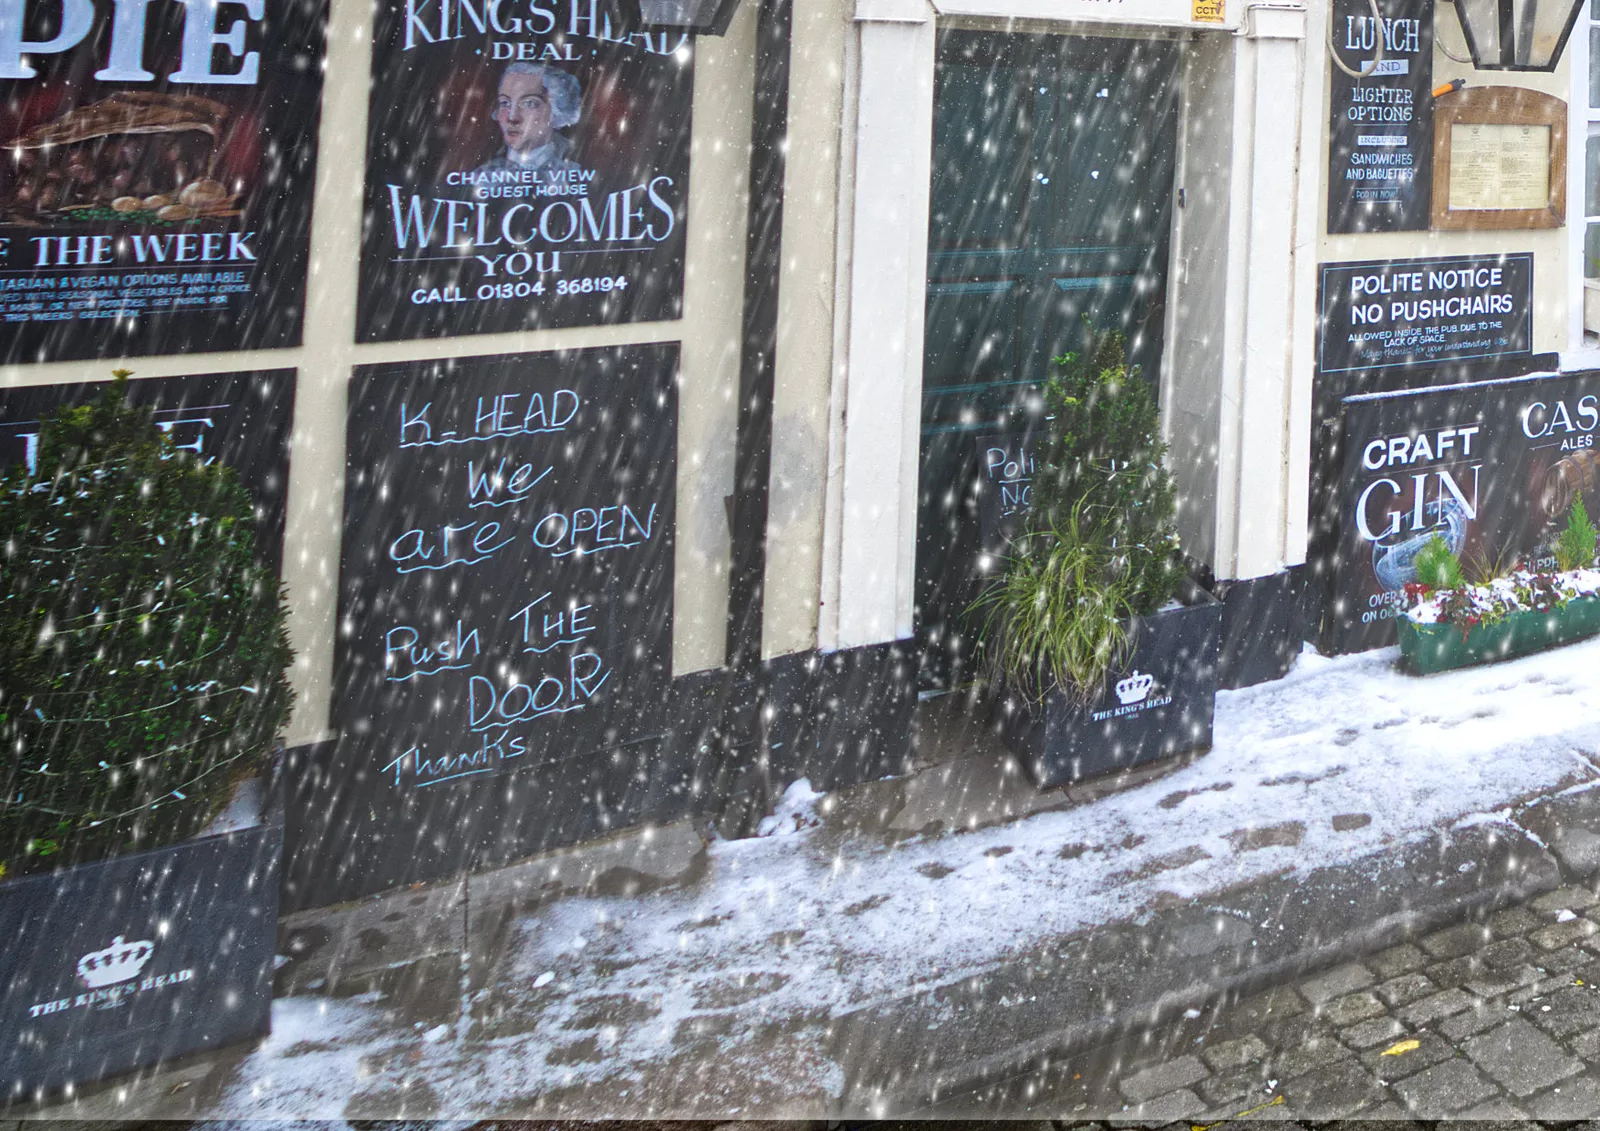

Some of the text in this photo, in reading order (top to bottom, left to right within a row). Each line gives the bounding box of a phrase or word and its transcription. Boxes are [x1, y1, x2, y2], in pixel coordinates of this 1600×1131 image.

[1196, 6, 1221, 14] CCTV
[1346, 16, 1419, 52] LUNCH
[491, 41, 583, 61] DEAL
[1352, 88, 1413, 104] LIGHTER
[1348, 106, 1413, 121] OPTIONS
[1351, 153, 1413, 165] SANDWICHES
[447, 169, 596, 186] CHANNEL VIEW
[1346, 168, 1413, 181] AND BAGUETTES
[476, 183, 588, 199] GUEST HOUSE
[387, 176, 675, 249] WELCOMES
[29, 235, 113, 266] THE
[131, 231, 257, 263] WEEK
[476, 251, 563, 277] YOU
[70, 276, 119, 288] VEGAN
[122, 274, 178, 287] OPTIONS
[181, 272, 245, 284] AVAILABLE
[119, 286, 183, 297] VEGETABLES
[186, 286, 208, 294] AND
[218, 284, 251, 293] CHOICE
[411, 275, 628, 305] CALL 01304 368194
[1351, 268, 1502, 297] POLITE NOTICE
[210, 295, 228, 304] FOR
[1351, 294, 1513, 325] NO PUSHCHAIRS
[1348, 331, 1392, 343] ALLOWED
[1394, 327, 1422, 338] INSIDE
[1425, 326, 1440, 336] THE
[1460, 323, 1477, 332] DUE
[1478, 321, 1488, 330] TO
[1489, 320, 1502, 329] THE
[1384, 338, 1405, 348] LACK
[1407, 336, 1418, 345] OF
[475, 389, 580, 434] HEAD
[1363, 427, 1479, 470] CRAFT
[1560, 434, 1593, 451] ALES
[987, 447, 1035, 478] Poli
[468, 457, 553, 499] We
[1356, 464, 1482, 541] GIN
[389, 502, 657, 561] are OPEN
[386, 591, 596, 670] Push THE
[469, 652, 611, 727] DOOR
[1092, 709, 1112, 721] THE
[1146, 696, 1172, 708] HEAD
[28, 997, 71, 1018] THE
[74, 982, 136, 1008] KING'S
[140, 969, 193, 992] HEAD
